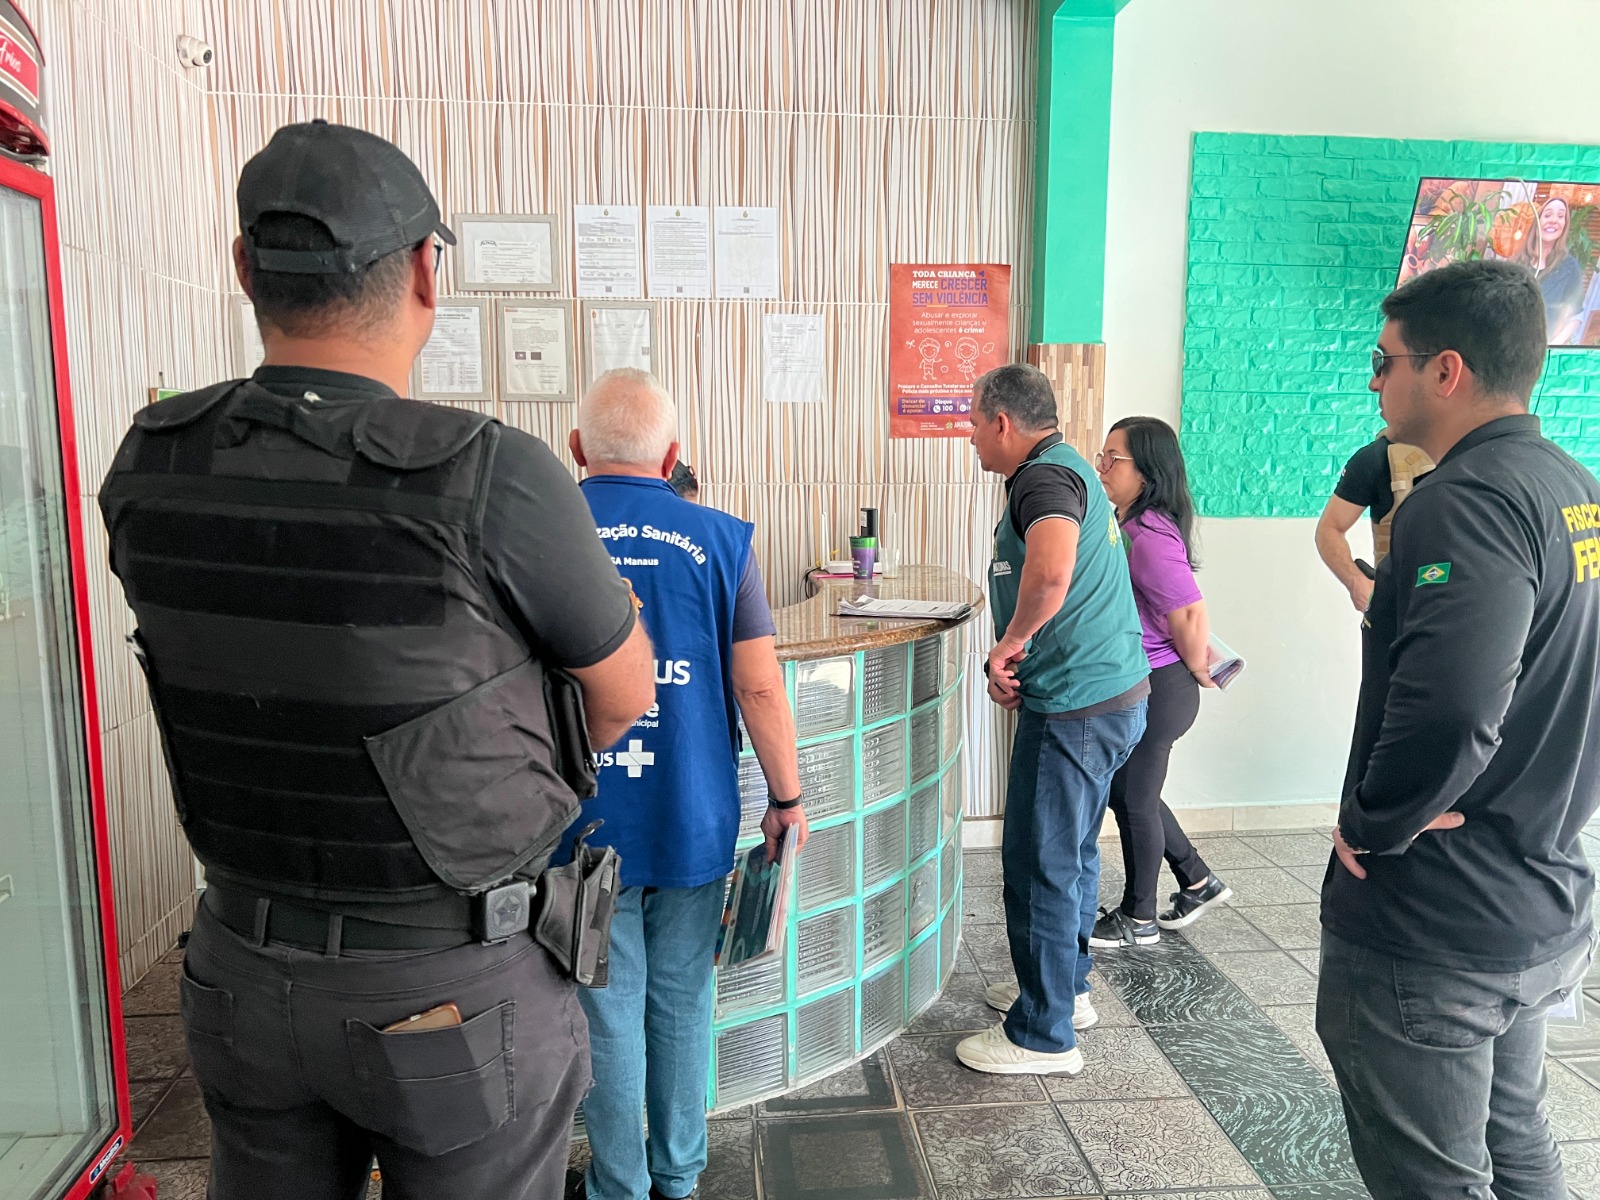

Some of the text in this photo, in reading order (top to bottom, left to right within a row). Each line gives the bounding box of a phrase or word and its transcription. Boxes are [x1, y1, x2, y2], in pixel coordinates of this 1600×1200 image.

[912, 270, 976, 279] TODA CRIANÇA
[912, 278, 988, 291] MERECE CRESCER
[912, 290, 988, 305] SEM VIOLÊNCIA
[951, 312, 978, 320] explorar
[954, 320, 980, 328] crianças
[964, 326, 985, 334] crime!
[595, 523, 707, 566] zação Sanitária
[623, 556, 659, 566] Manaus
[653, 659, 691, 686] US
[631, 719, 659, 729] nicipal
[592, 752, 614, 767] US
